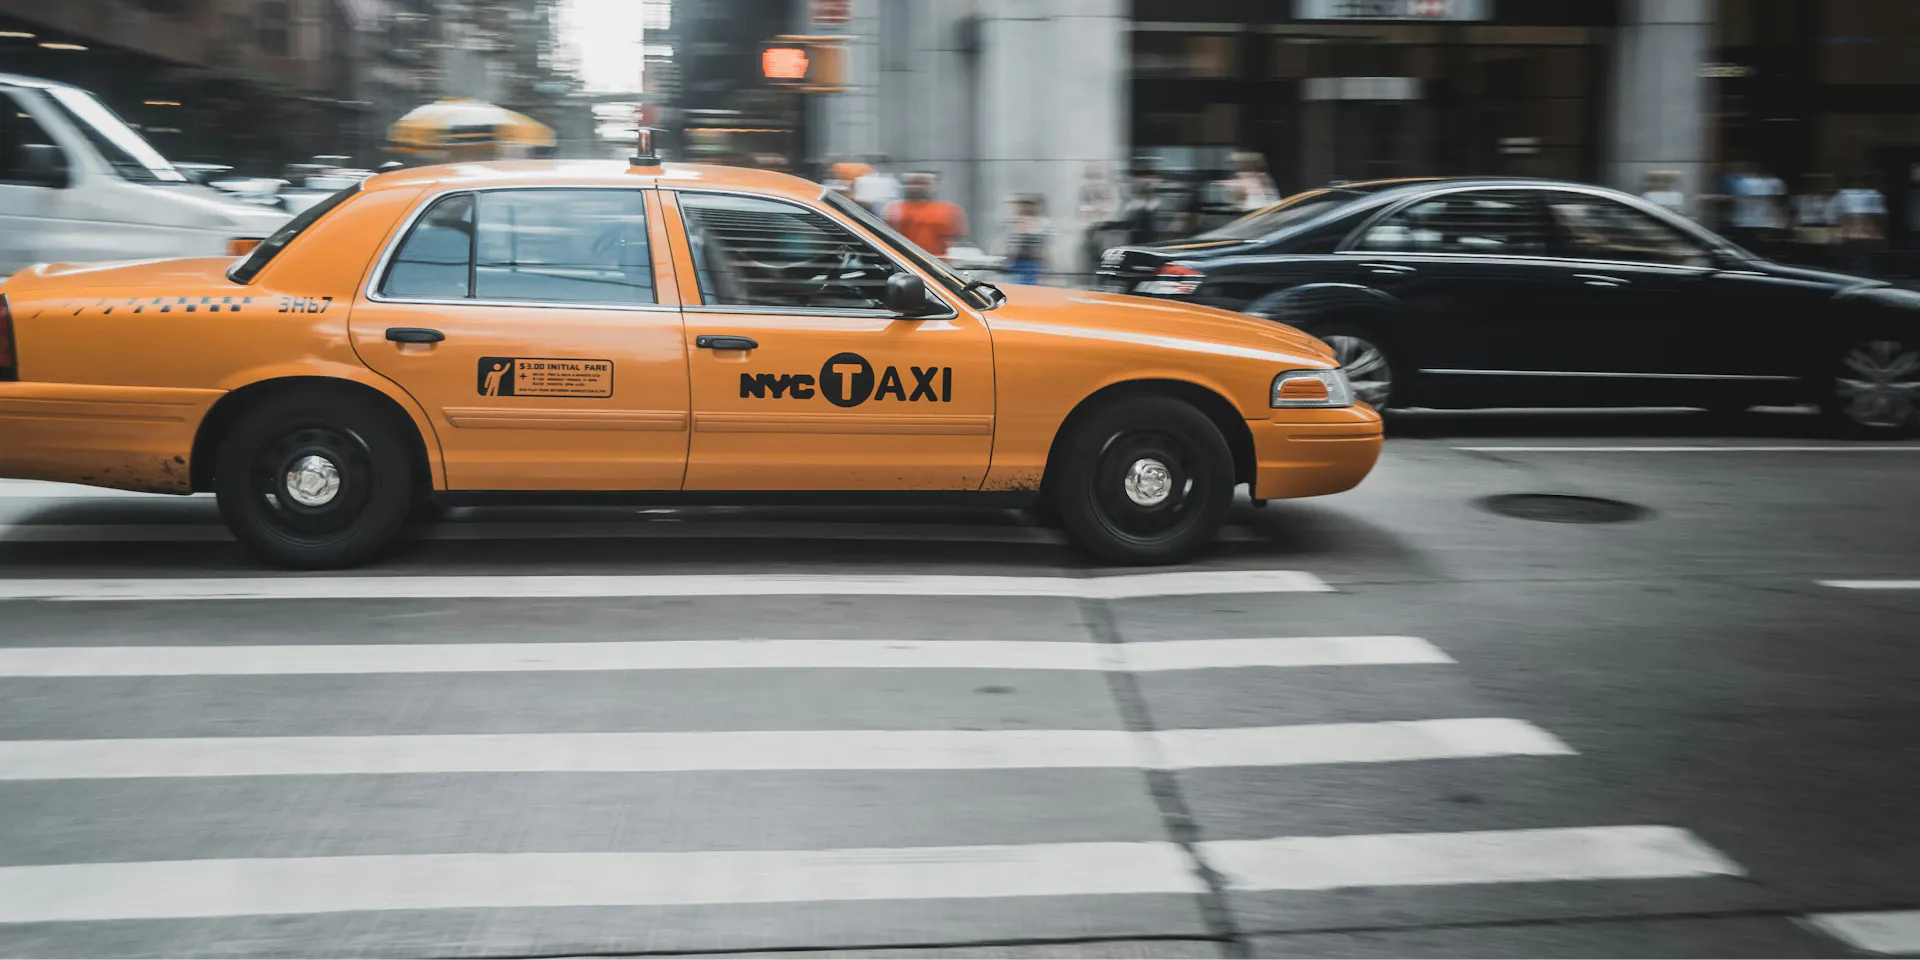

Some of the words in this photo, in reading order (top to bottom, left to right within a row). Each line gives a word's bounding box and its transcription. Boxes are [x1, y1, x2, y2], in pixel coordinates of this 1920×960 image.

[278, 296, 333, 313] 3H67
[740, 373, 815, 399] NYC
[829, 361, 952, 403] TAXI
